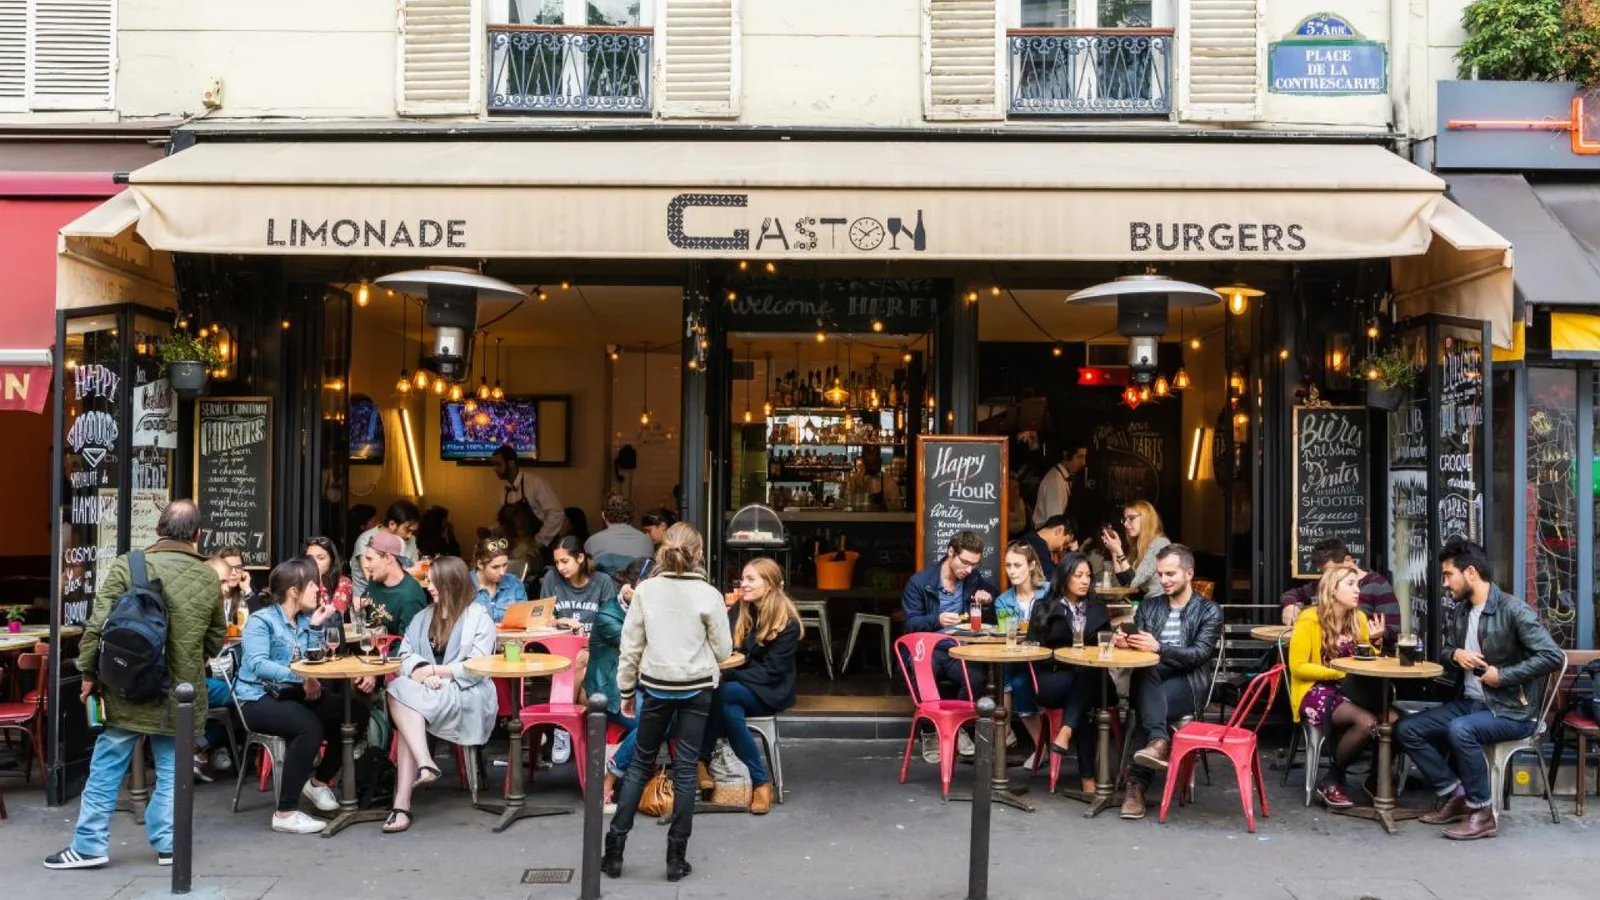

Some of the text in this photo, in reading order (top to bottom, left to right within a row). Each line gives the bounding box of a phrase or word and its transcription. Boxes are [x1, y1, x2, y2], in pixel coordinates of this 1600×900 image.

[1305, 50, 1352, 62] PLACE
[1308, 63, 1348, 76] DE LA
[1275, 77, 1380, 90] CONTRESCARPE
[266, 218, 467, 248] LIMONADE
[1130, 221, 1306, 252] BURGERS
[74, 364, 120, 402] HAPPY
[1300, 413, 1362, 451] Bières
[931, 447, 986, 486] Happy
[1440, 452, 1472, 472] CROQUE
[1302, 496, 1365, 507] SHOOTER
[938, 519, 989, 534] Kronenbourg
[202, 529, 213, 548] 7
[212, 531, 247, 547] JOURS
[253, 531, 265, 549] 7
